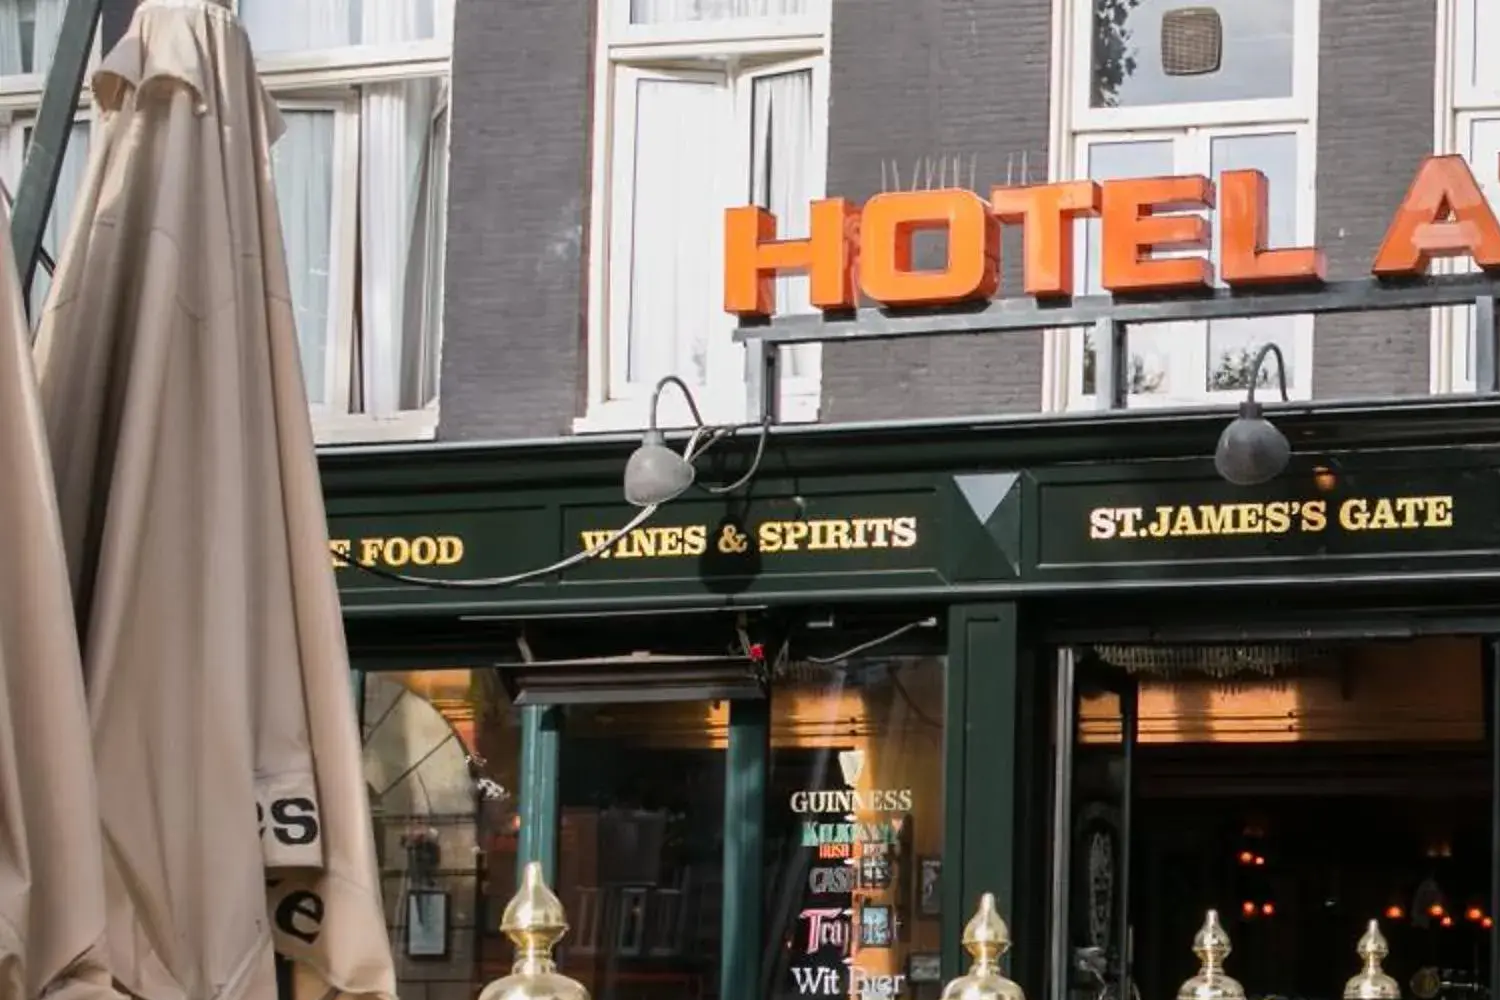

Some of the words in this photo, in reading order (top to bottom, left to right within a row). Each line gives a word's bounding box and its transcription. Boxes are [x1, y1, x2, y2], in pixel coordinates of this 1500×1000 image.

[724, 168, 1327, 316] HOTEL
[1090, 499, 1327, 540] ST.JAMES'S
[1338, 495, 1454, 531] GATE
[358, 535, 464, 567] FOOD
[581, 525, 708, 559] WINES
[717, 523, 748, 553] &
[758, 516, 917, 553] SPIRITS
[789, 788, 913, 814] GUINNESS
[790, 965, 841, 996] Wit
[847, 965, 906, 996] Bier
